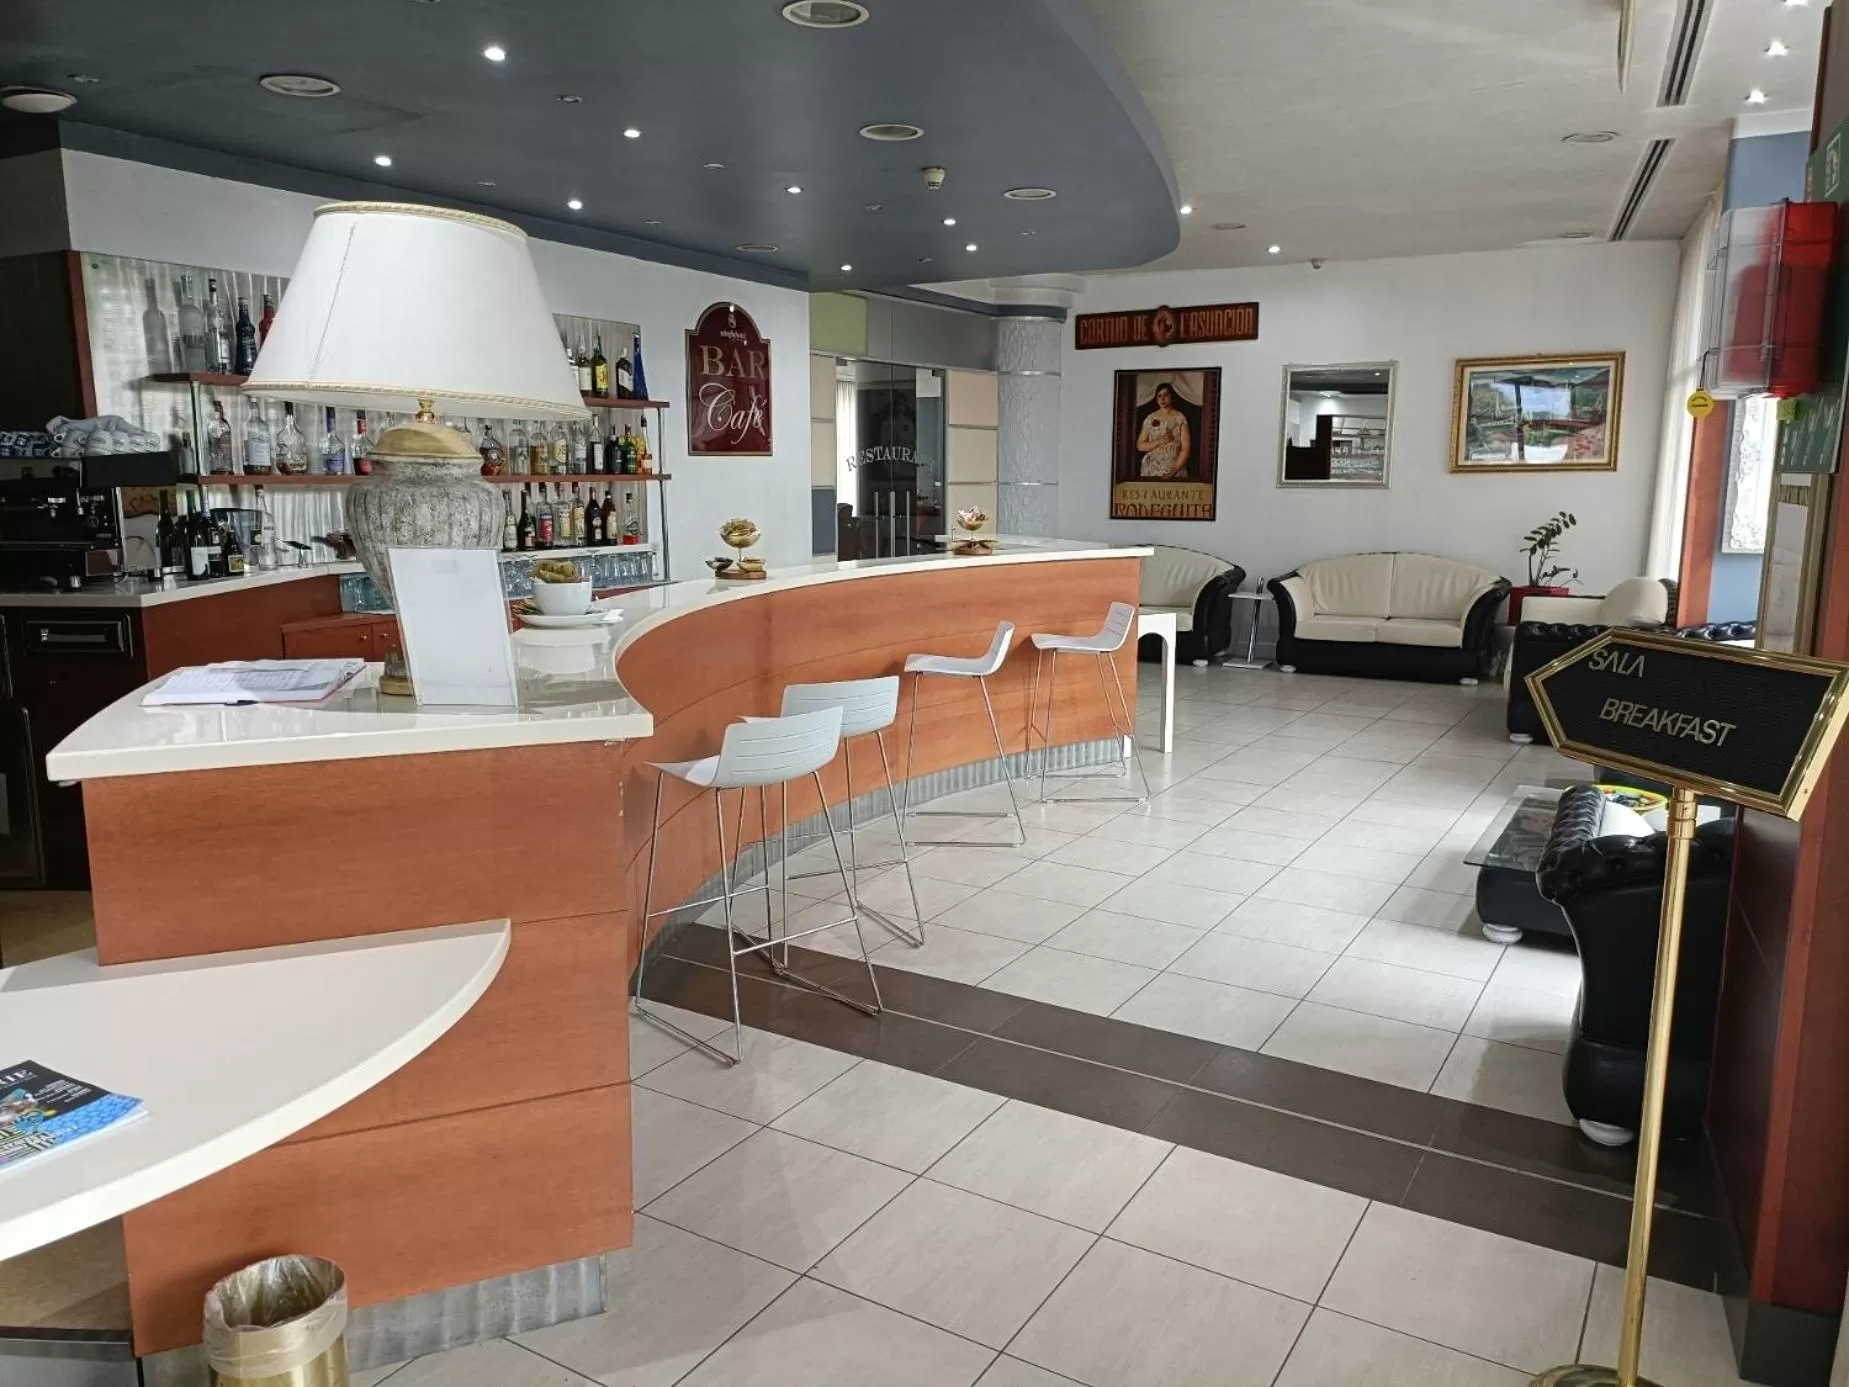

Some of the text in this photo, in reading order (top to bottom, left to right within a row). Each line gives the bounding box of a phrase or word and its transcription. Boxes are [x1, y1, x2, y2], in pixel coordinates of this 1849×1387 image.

[1133, 314, 1149, 342] DE
[699, 345, 767, 380] BAR
[698, 382, 768, 445] Café
[1121, 487, 1205, 501] RESTAURANTE
[1588, 649, 1645, 678] SALA
[1599, 697, 1737, 748] BREAKFAST
